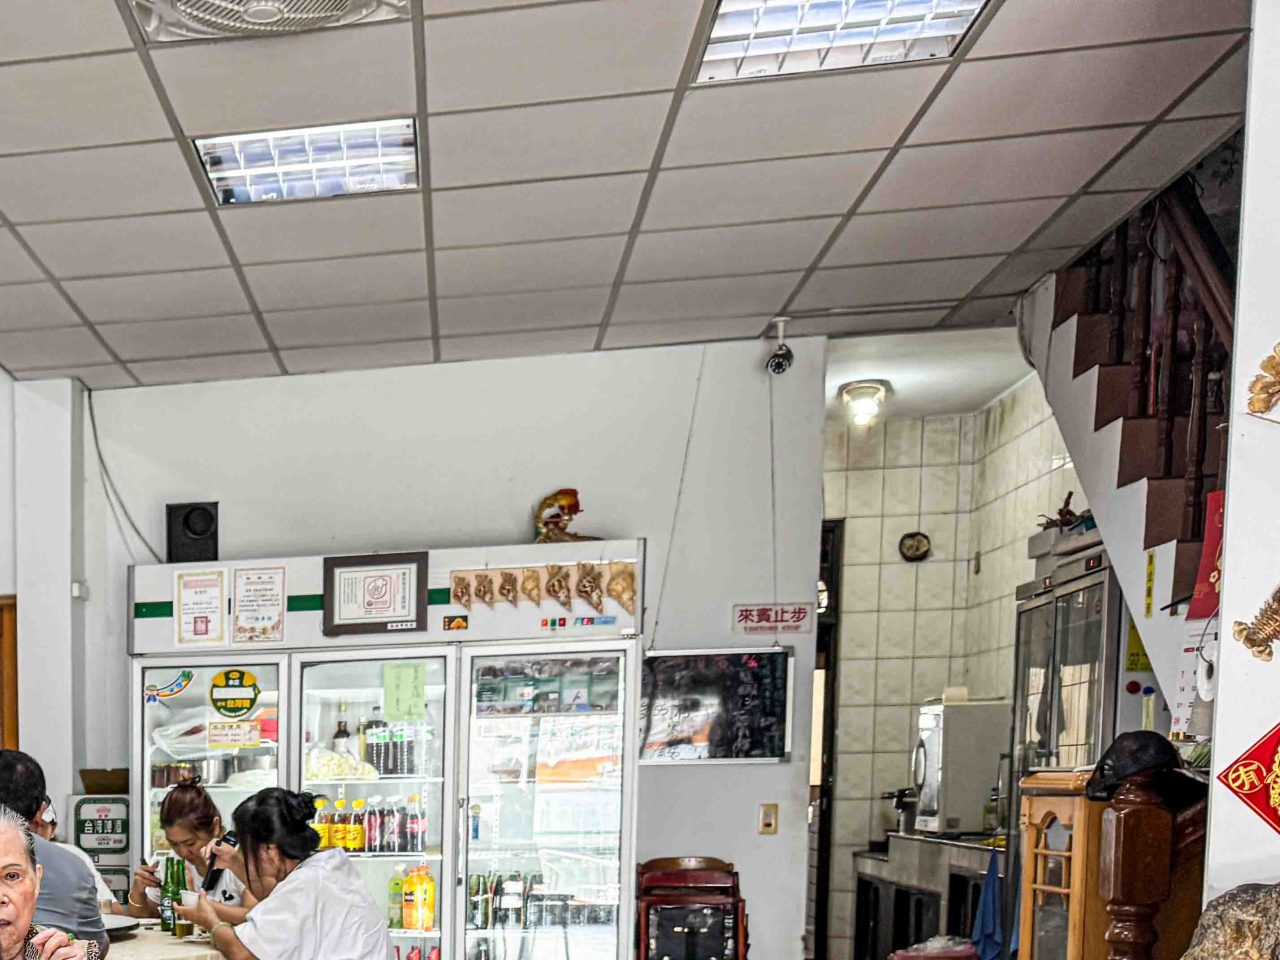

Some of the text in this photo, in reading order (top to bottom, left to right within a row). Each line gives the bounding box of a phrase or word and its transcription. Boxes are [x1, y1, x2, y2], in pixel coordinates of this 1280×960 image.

[737, 606, 808, 624] 來賓止步
[1231, 762, 1261, 791] 有
